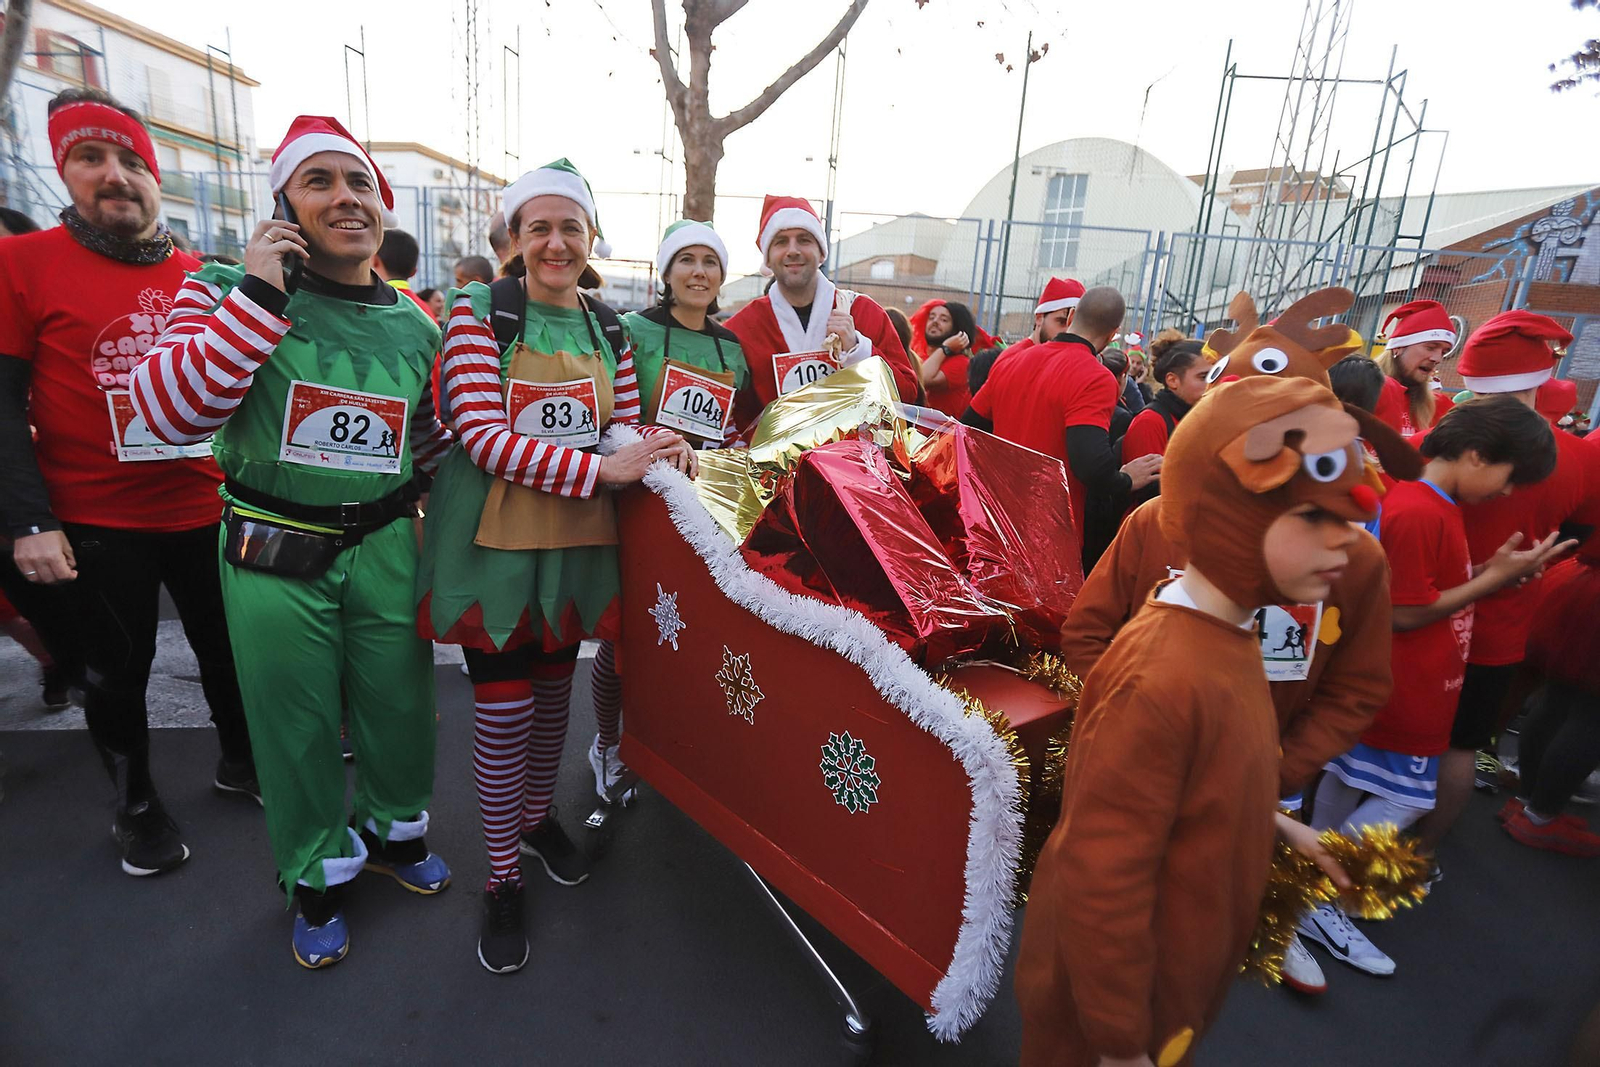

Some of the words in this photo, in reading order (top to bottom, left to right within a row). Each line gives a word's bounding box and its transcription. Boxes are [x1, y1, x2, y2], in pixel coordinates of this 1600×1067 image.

[541, 401, 573, 429] 83
[682, 389, 714, 418] 104
[330, 411, 371, 446] 82
[314, 440, 341, 449] ROBERTO
